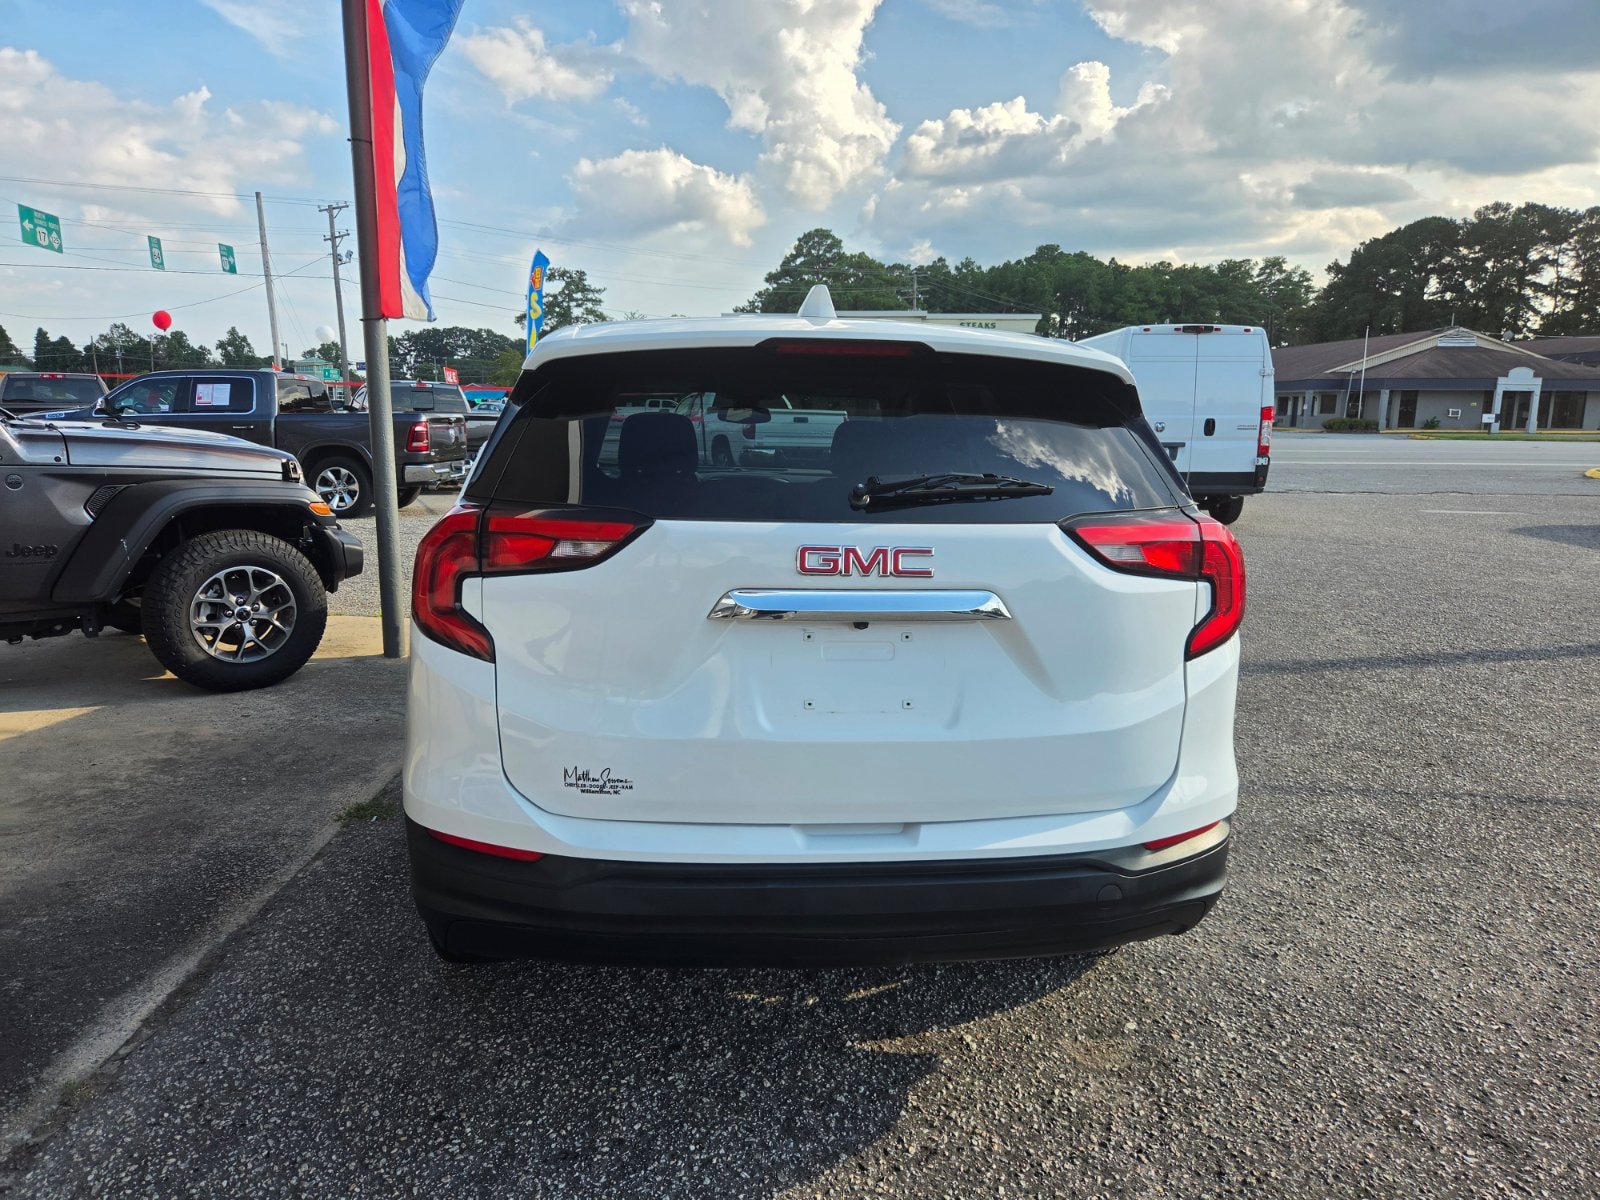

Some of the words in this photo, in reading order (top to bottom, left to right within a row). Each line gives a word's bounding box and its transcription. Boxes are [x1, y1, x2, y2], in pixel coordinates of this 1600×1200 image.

[38, 230, 47, 243] 17
[5, 543, 58, 559] Jeep
[796, 544, 935, 578] GMC
[564, 765, 600, 788] Matthew
